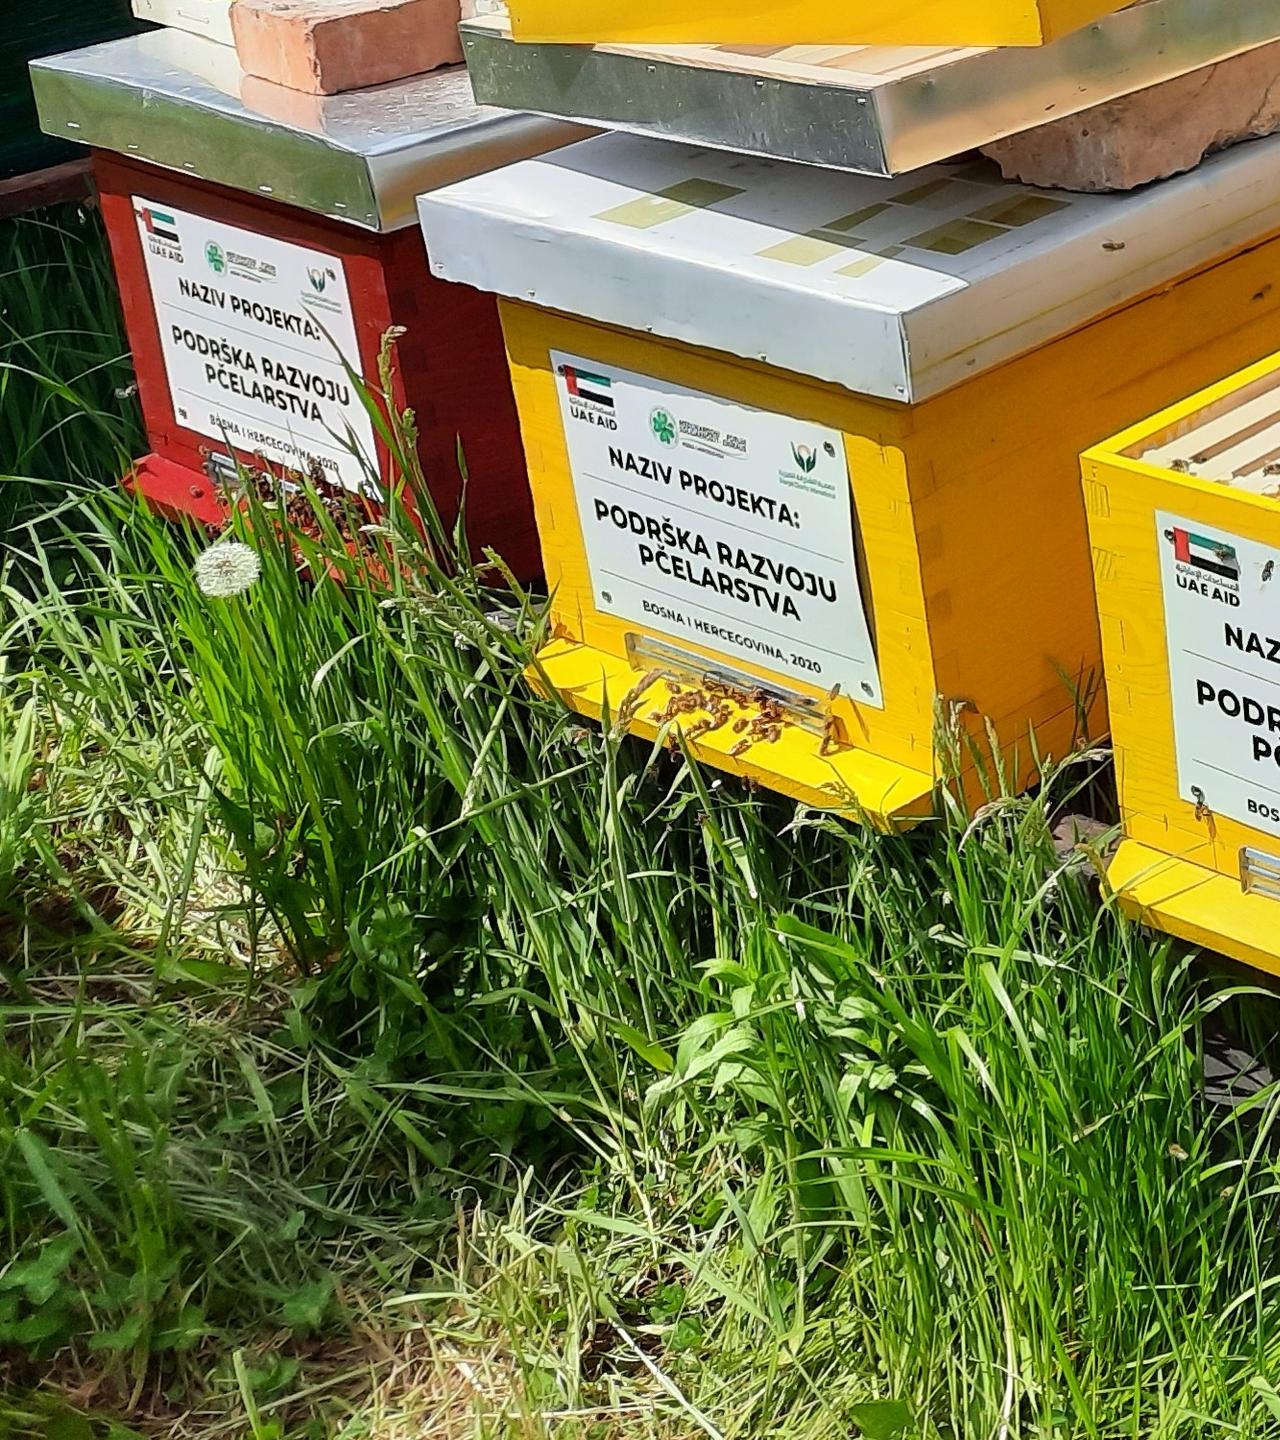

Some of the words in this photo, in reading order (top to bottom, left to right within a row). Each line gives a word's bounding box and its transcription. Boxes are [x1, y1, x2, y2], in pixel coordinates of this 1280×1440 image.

[178, 277, 225, 309] NAZIV
[230, 294, 321, 341] PROJEKTA:
[171, 324, 256, 374] PODRŠKA
[261, 357, 350, 406] RAZVOJU
[205, 363, 323, 422] PČELARSTVA
[570, 408, 595, 424] UAE
[597, 412, 618, 431] AID
[608, 446, 672, 485] NAZIV
[680, 470, 800, 529] PROJEKTA:
[593, 499, 711, 560] PODRŠKA
[717, 541, 838, 603] RAZVOJU
[638, 543, 801, 621] PČELARSTVA
[1176, 574, 1208, 597] UAE
[1212, 587, 1240, 607] AID
[642, 600, 685, 627] BOSNA
[688, 618, 692, 627] I
[695, 620, 788, 664] HERCEGOVINA,
[791, 654, 822, 674] 2020
